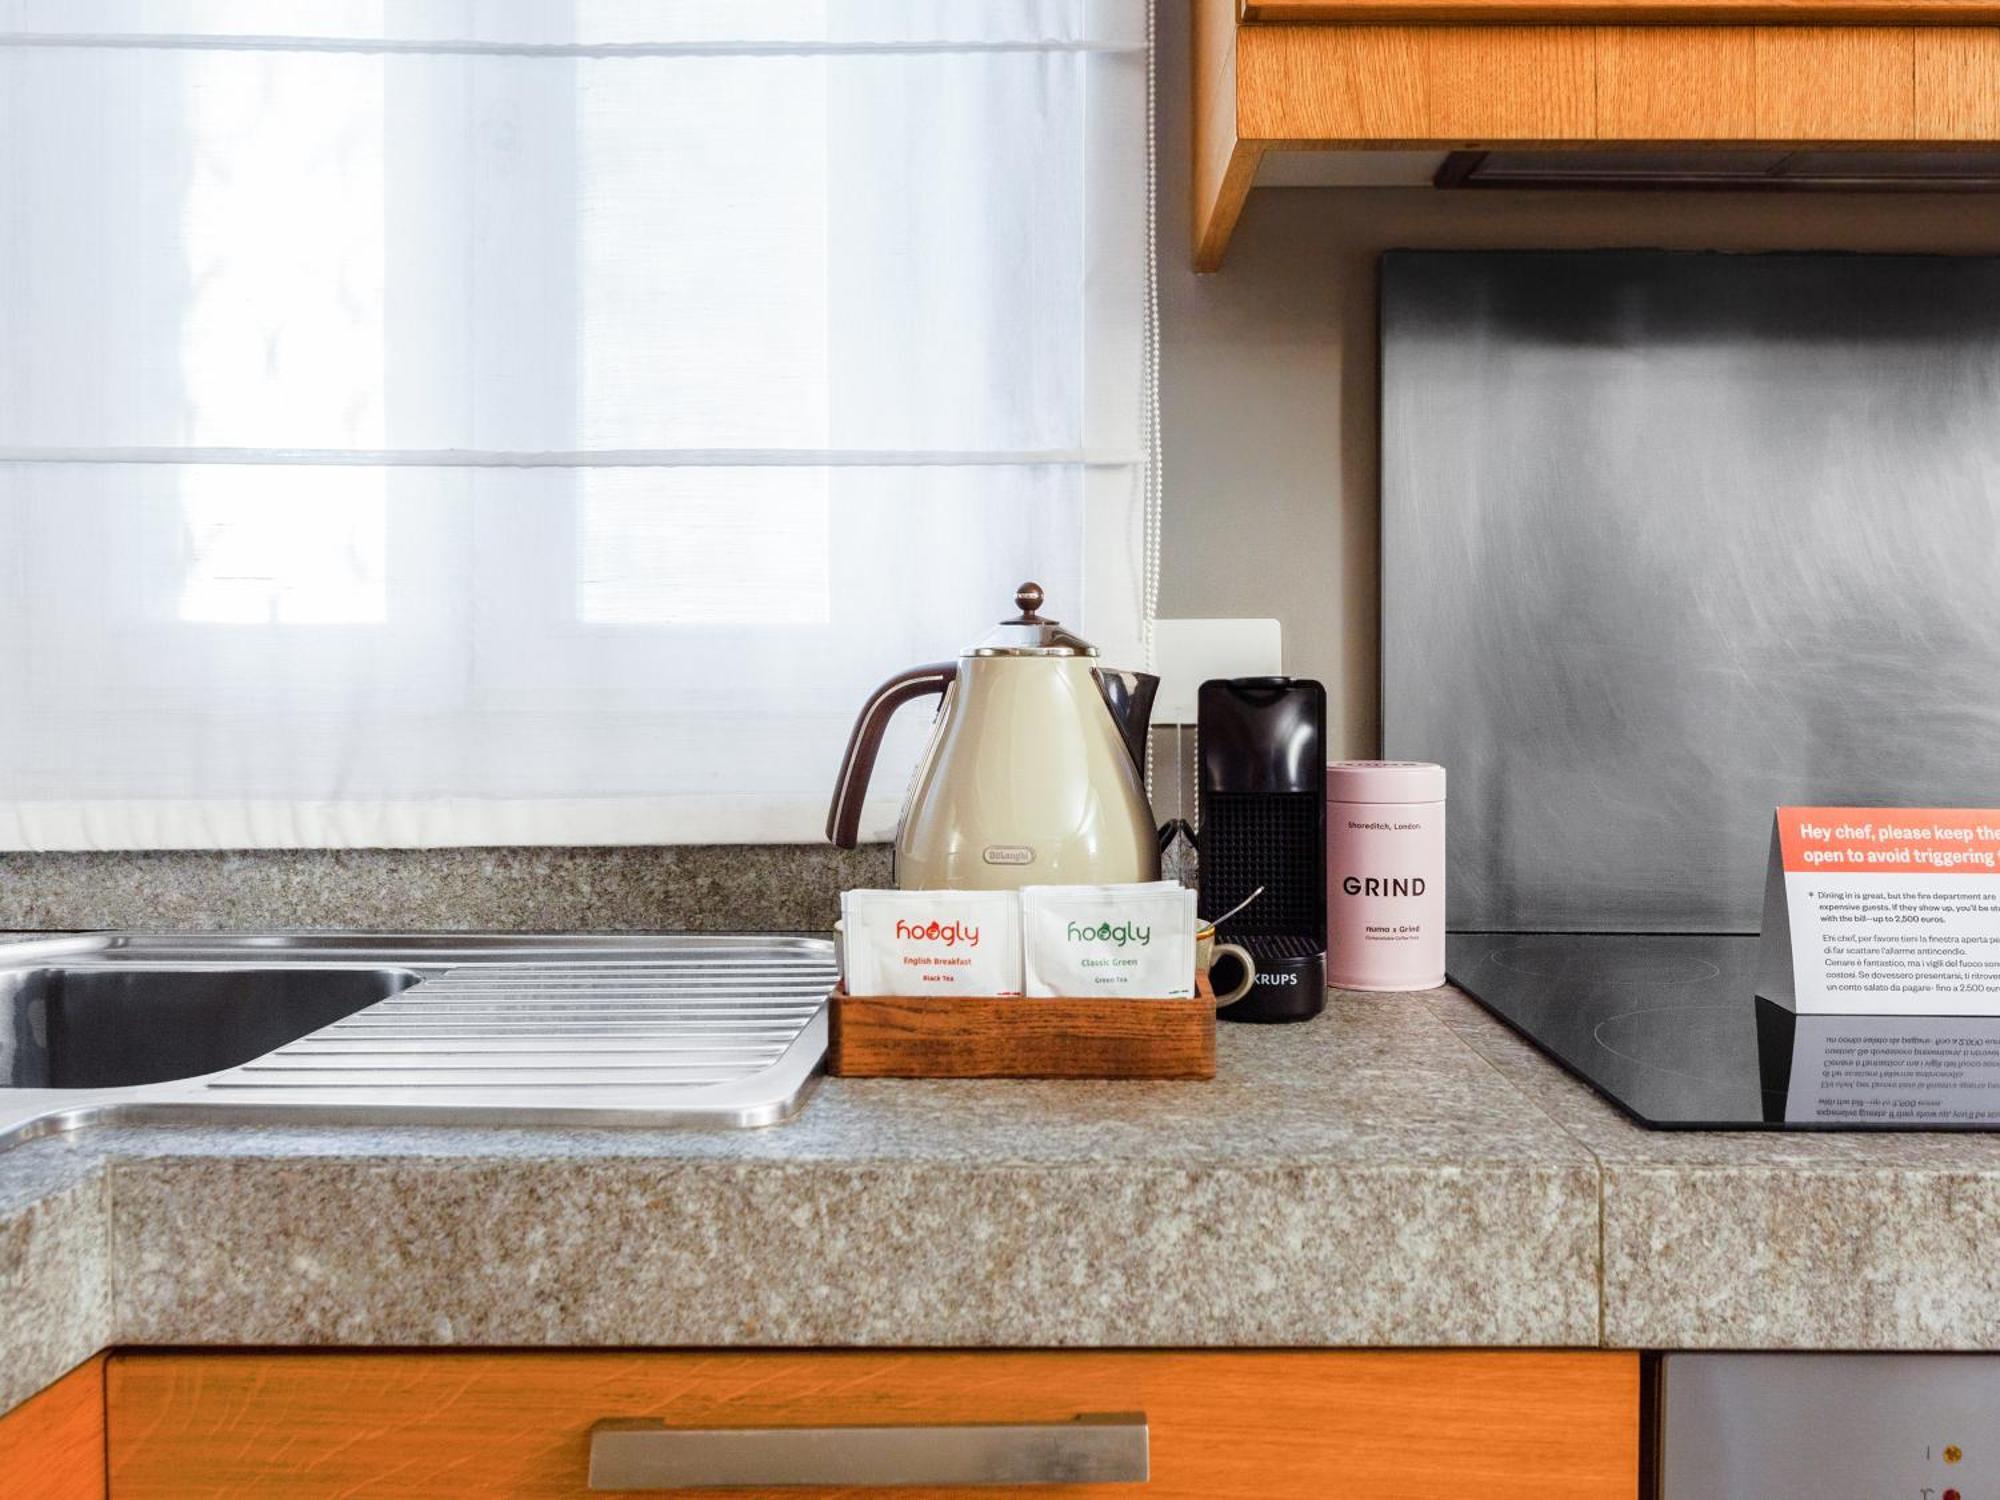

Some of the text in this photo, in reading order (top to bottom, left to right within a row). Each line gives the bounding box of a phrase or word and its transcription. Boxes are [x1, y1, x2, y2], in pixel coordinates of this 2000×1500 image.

[1800, 824, 2000, 842] Hey chef, please keep the
[1804, 851, 1844, 865] open
[1847, 849, 1864, 863] to
[1867, 849, 1910, 863] avoid
[1913, 849, 1995, 867] triggering
[1343, 876, 1425, 896] GRIND
[1817, 892, 1844, 901] Dining
[1854, 892, 1861, 900] is
[1862, 892, 1886, 901] great,
[1887, 892, 1901, 900] but
[1902, 892, 1916, 900] the
[1917, 892, 1932, 900] fire
[1932, 892, 1981, 902] department
[1819, 904, 1860, 912] expensive
[1899, 904, 1917, 913] they
[1918, 904, 1940, 912] show
[1820, 915, 1838, 923] with
[1839, 915, 1853, 923] the
[896, 919, 980, 946] hoogly
[1067, 921, 1151, 947] hoogly
[1858, 936, 1872, 944] per
[1919, 935, 1927, 943] la
[1928, 935, 1960, 943] finestra
[1961, 936, 1988, 945] aperta
[1833, 946, 1844, 954] far
[903, 957, 972, 966] English Breakfast
[1081, 958, 1109, 967] Classic
[1863, 958, 1905, 968] fantastico,
[1959, 960, 1983, 968] fuoco
[1871, 971, 1914, 979] dovessero
[1863, 984, 1889, 992] salato
[1890, 984, 1901, 992] da
[1935, 984, 1952, 992] fino
